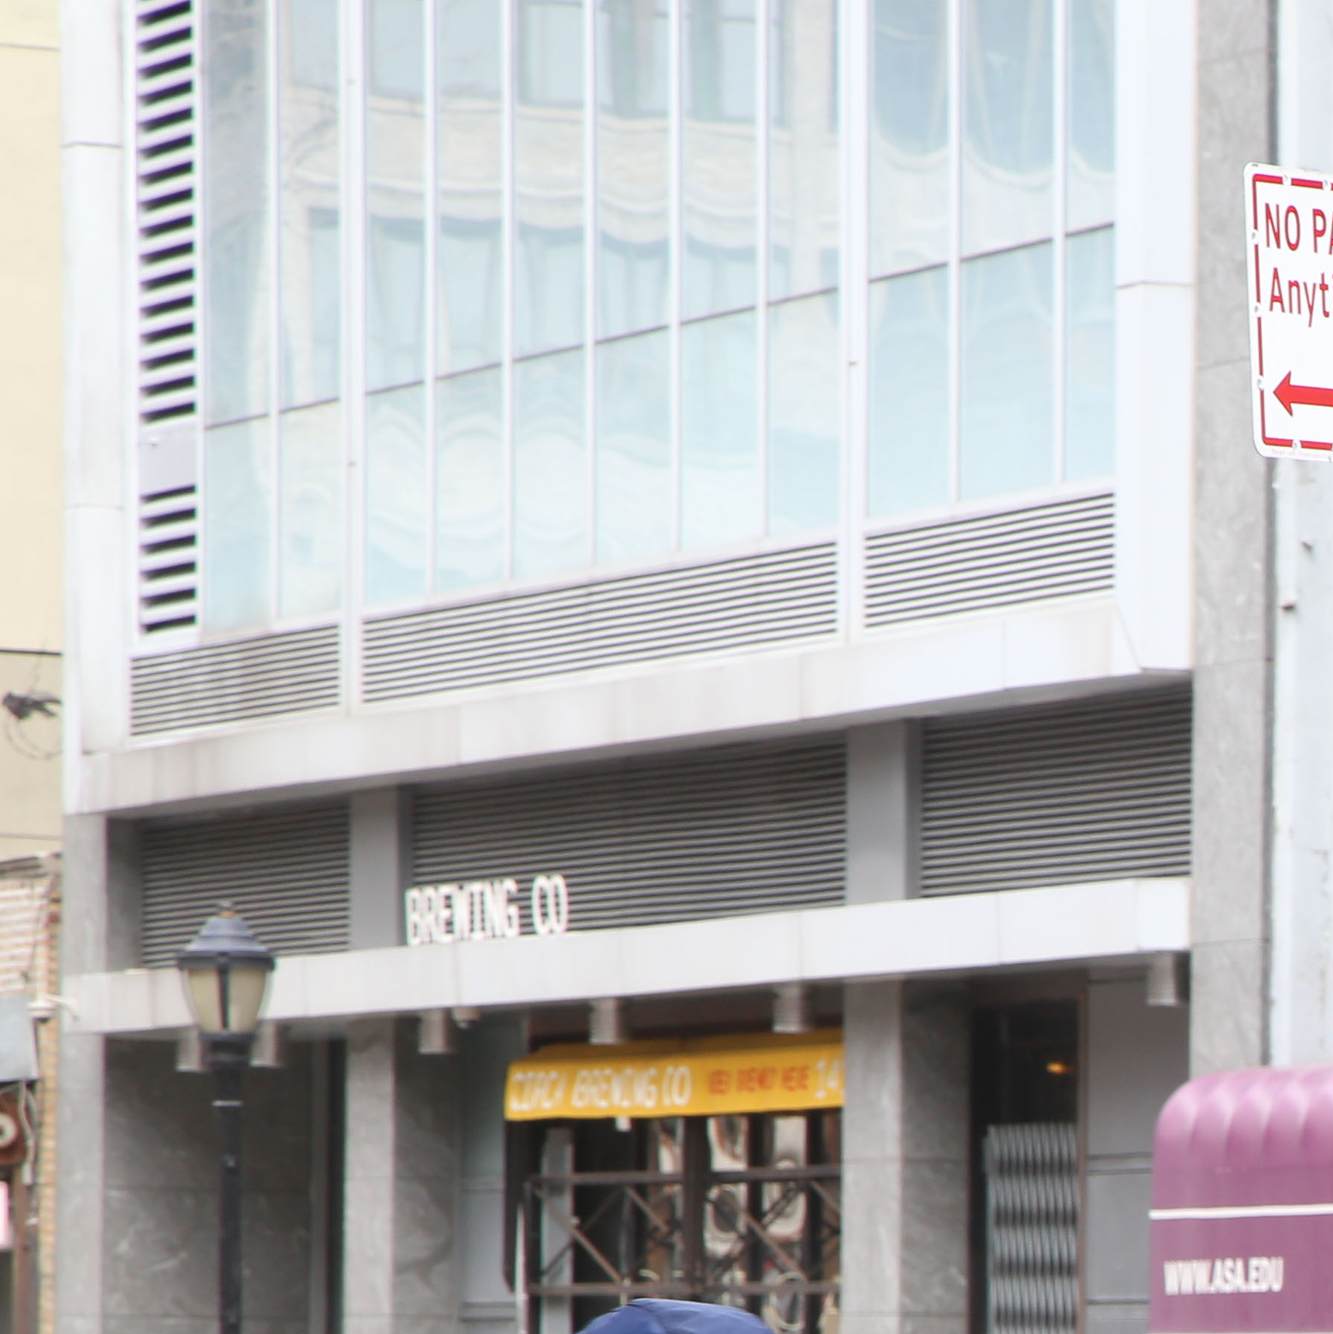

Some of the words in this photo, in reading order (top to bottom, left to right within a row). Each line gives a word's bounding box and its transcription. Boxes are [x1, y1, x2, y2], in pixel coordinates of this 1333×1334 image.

[1265, 203, 1301, 251] NO
[405, 877, 521, 945] BREWING
[532, 872, 568, 936] CO
[1163, 1257, 1284, 1296] WWW.ASA.EDU
